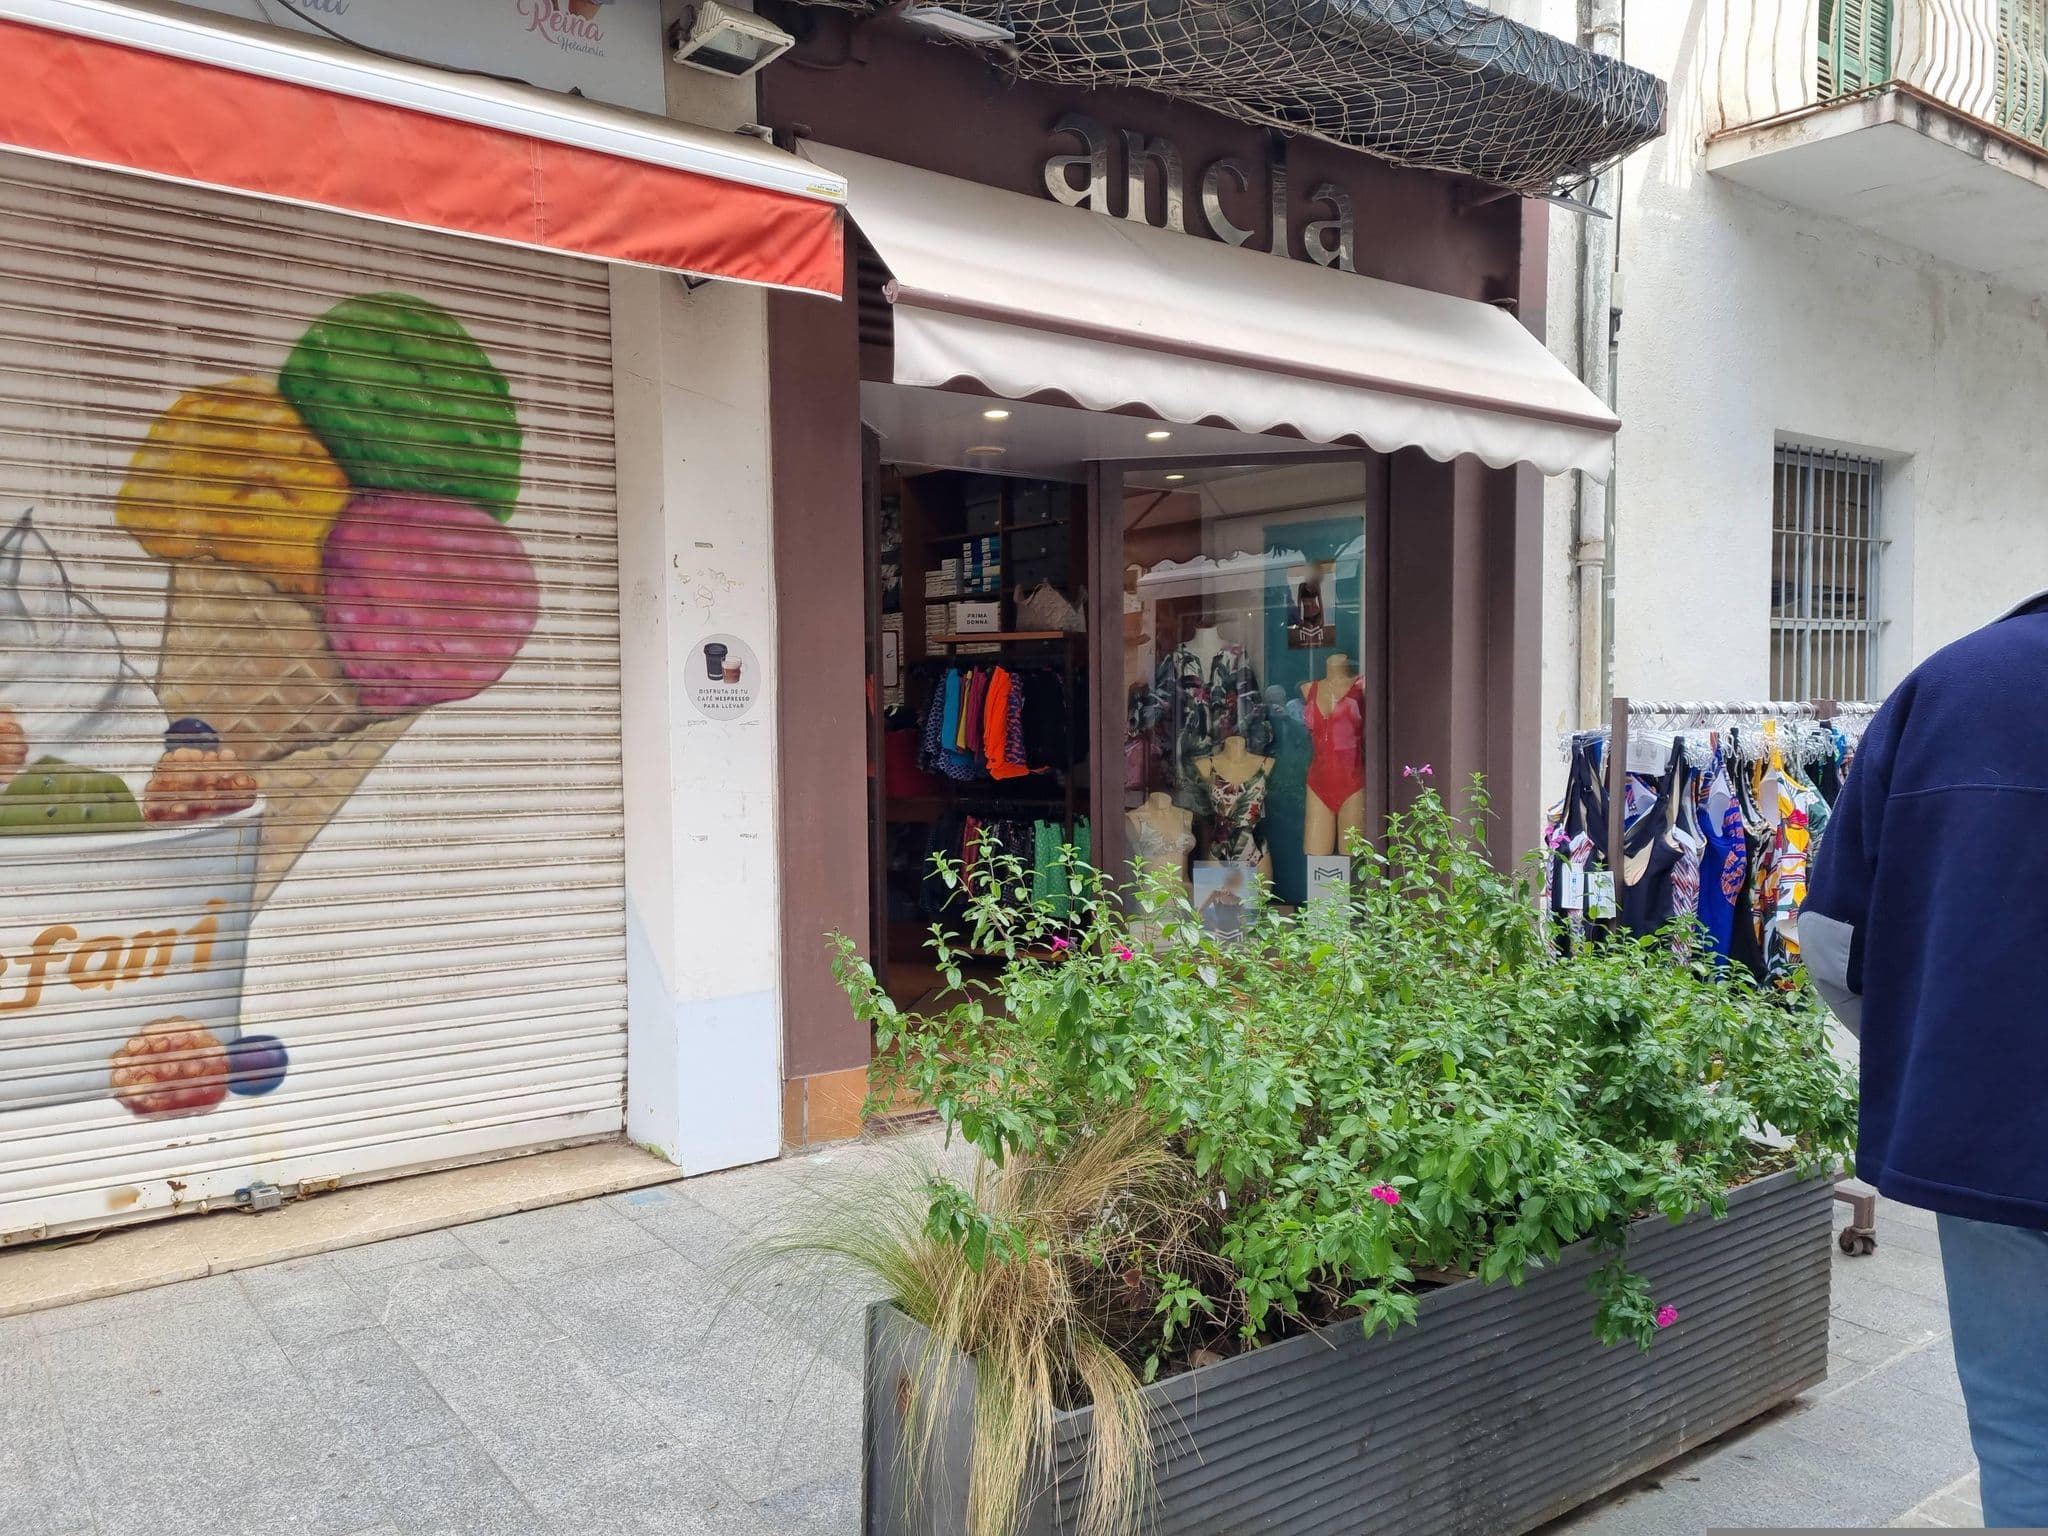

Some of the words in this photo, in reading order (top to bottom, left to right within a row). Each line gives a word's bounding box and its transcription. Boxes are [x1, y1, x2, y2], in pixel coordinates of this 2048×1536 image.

[516, 0, 605, 45] Reina
[1044, 113, 1357, 273] ancla
[0, 898, 226, 1011] fani
